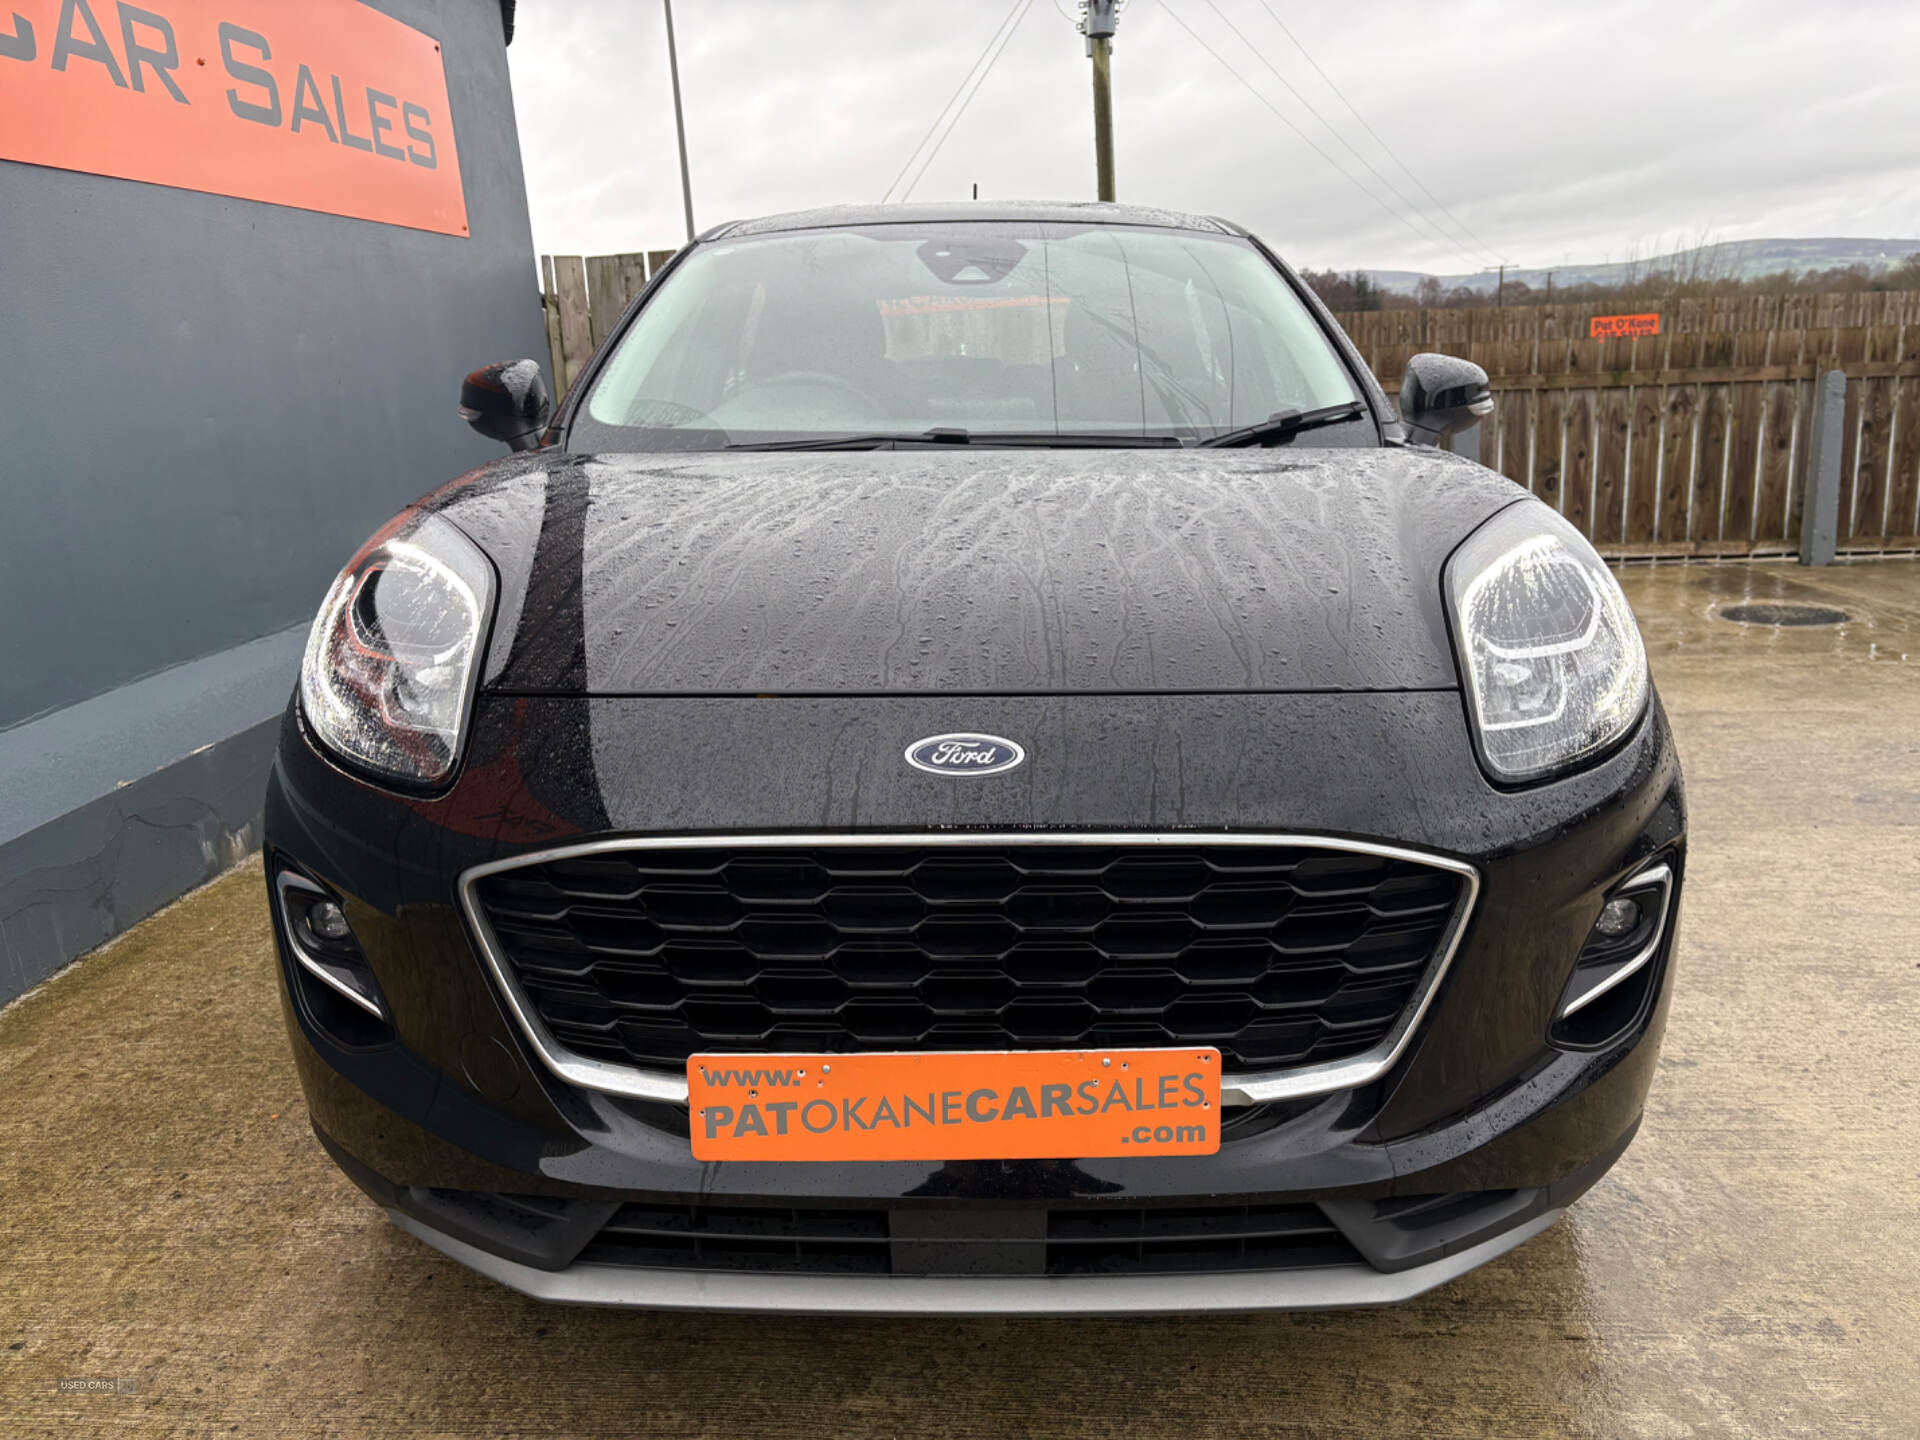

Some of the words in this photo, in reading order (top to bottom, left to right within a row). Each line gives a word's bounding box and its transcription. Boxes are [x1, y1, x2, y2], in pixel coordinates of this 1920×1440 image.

[218, 21, 438, 170] SALES
[931, 741, 997, 765] Ford
[703, 1069, 801, 1087] www.
[1120, 1124, 1207, 1144] .com
